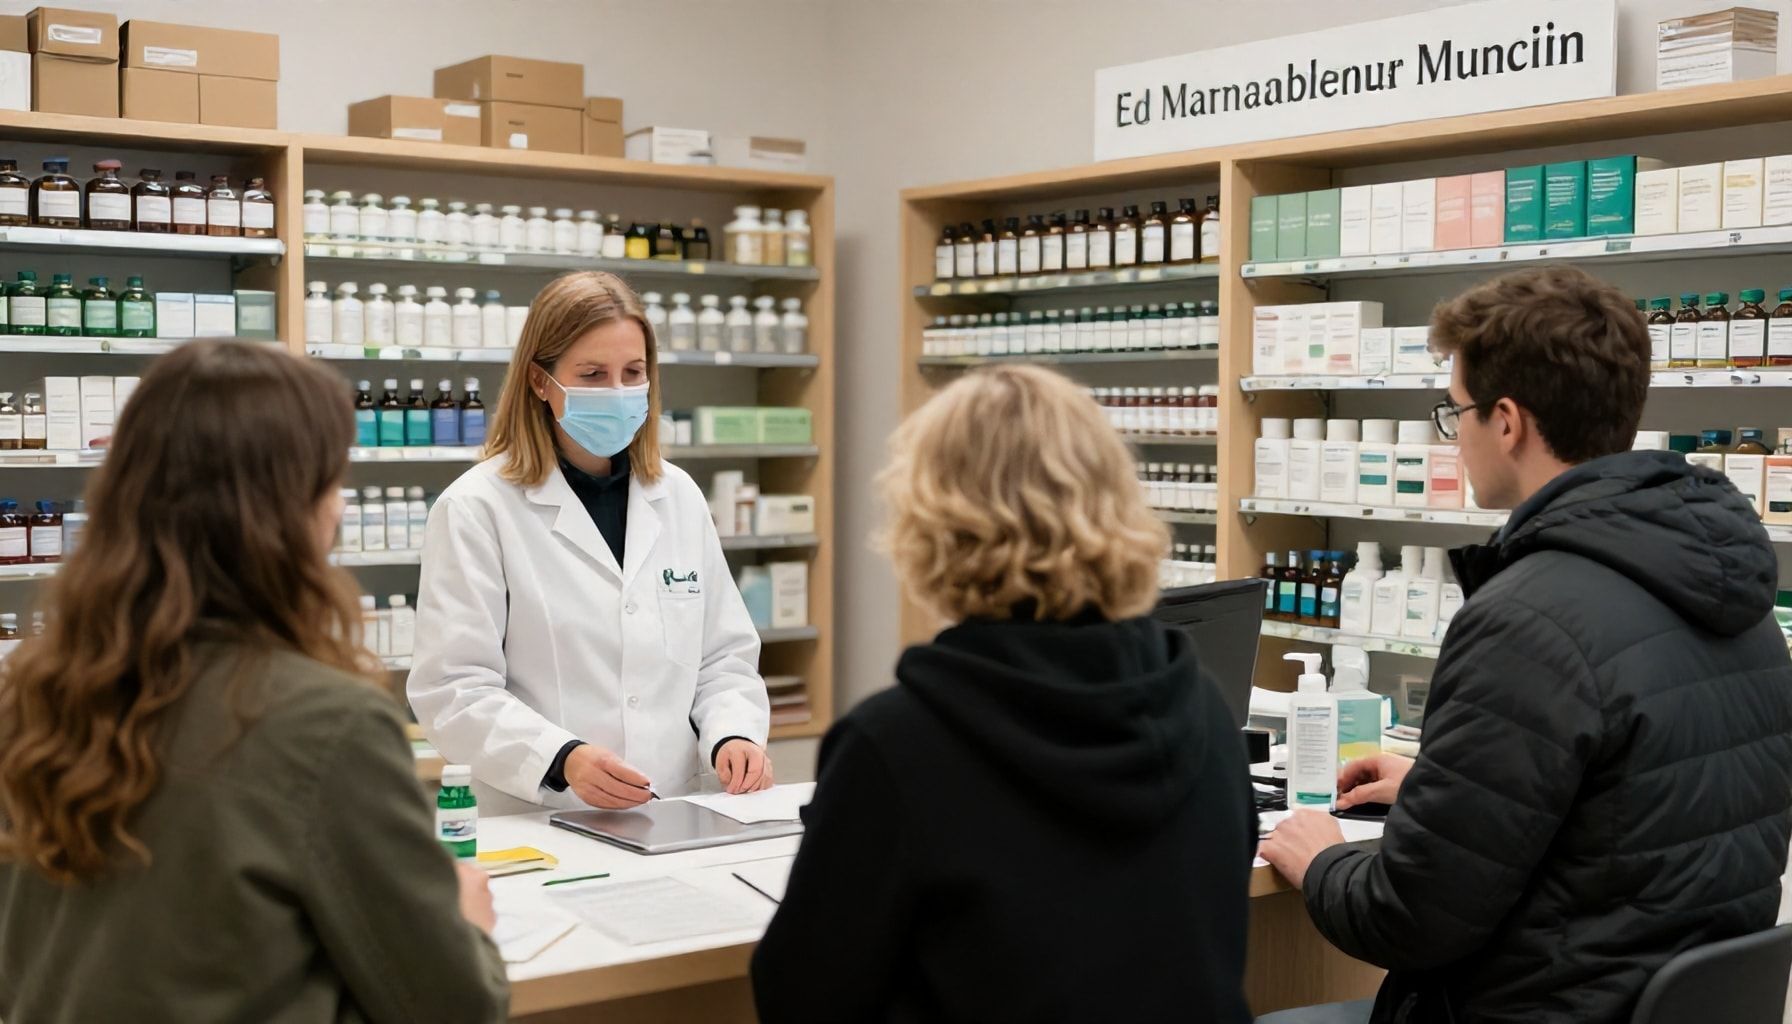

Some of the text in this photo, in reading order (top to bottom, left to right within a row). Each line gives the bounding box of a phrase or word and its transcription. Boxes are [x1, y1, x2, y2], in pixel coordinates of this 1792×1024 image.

[1116, 21, 1585, 128] Ed Marnaablenur Munciin
